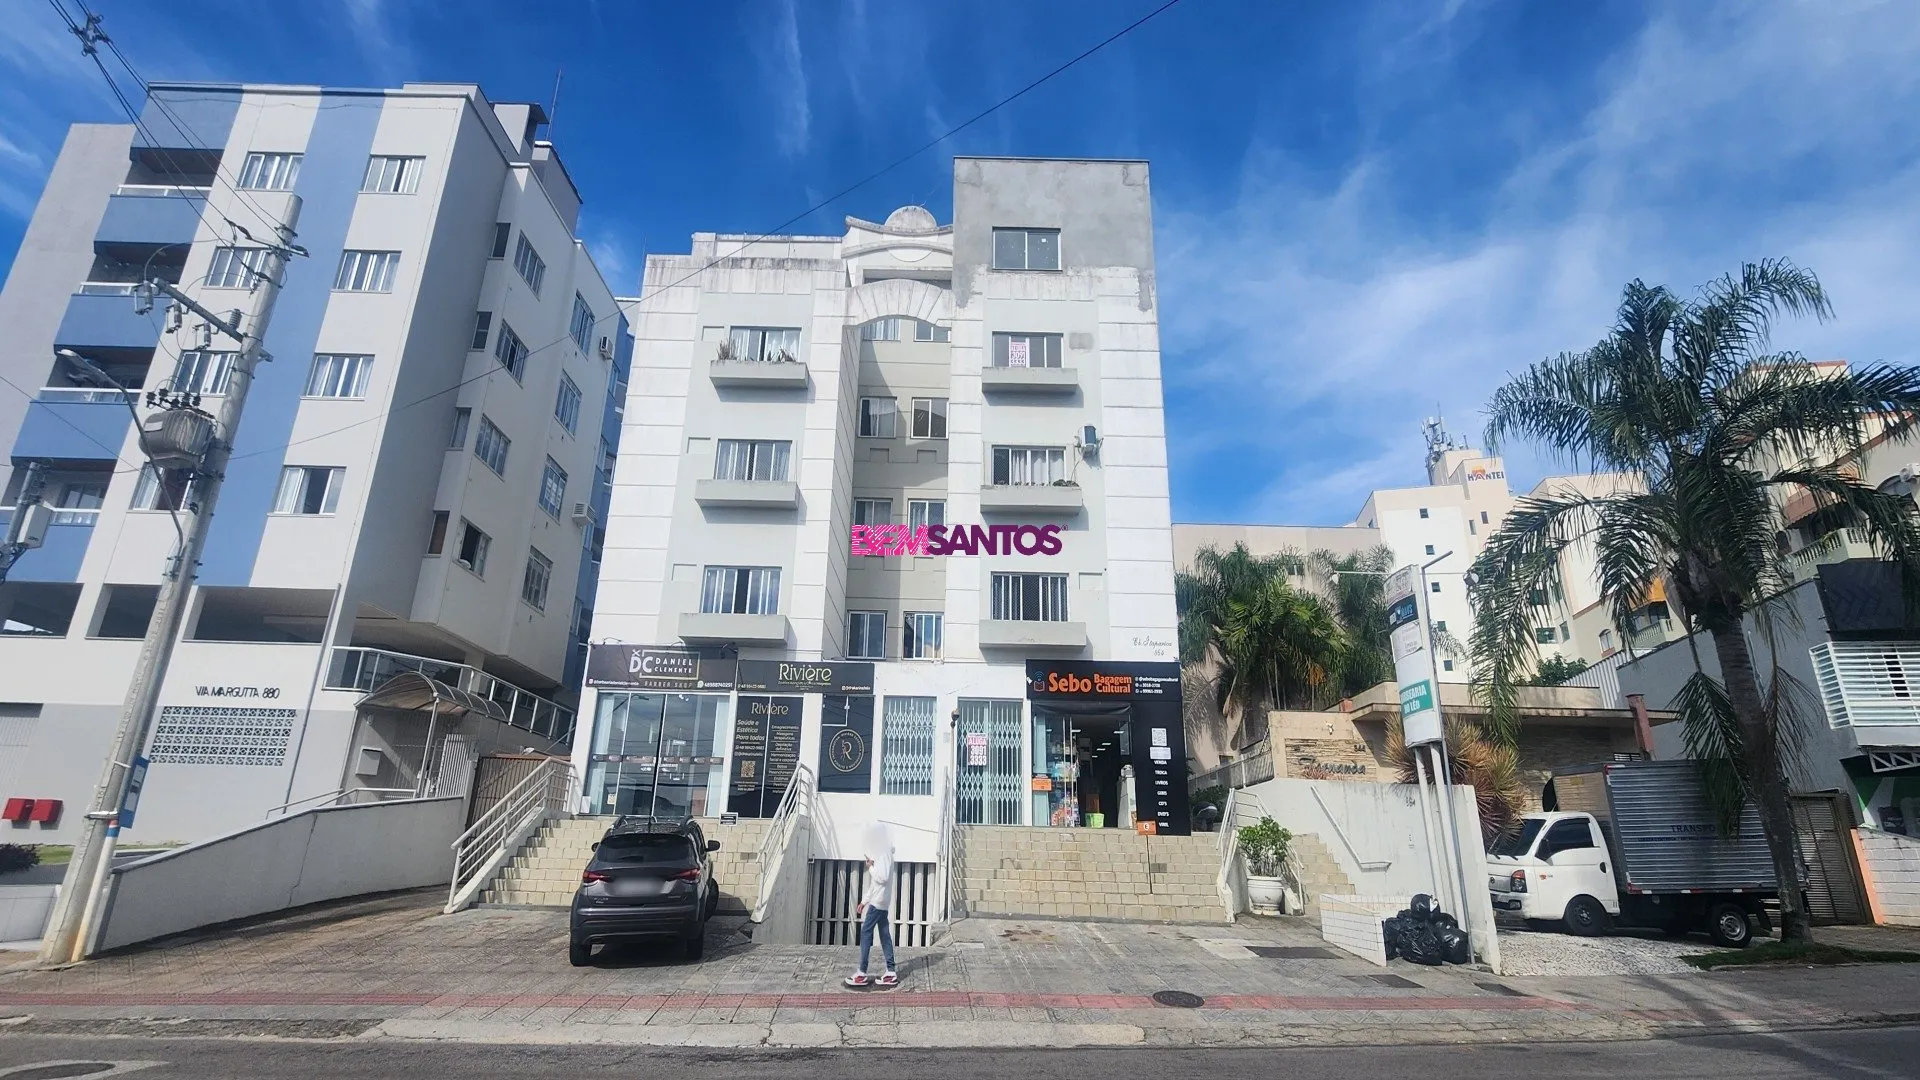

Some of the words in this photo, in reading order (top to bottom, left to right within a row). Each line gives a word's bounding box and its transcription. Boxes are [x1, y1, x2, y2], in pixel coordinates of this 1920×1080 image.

[629, 656, 653, 673] DC
[655, 657, 693, 667] DANIEL
[654, 665, 693, 674] CLEMENTE
[779, 663, 832, 681] Rivière
[644, 680, 671, 688] BARBER
[674, 681, 693, 689] SHOP
[1048, 672, 1091, 693] Sebo
[1093, 674, 1132, 684] Bagagem
[195, 685, 209, 697] VIA
[211, 686, 259, 698] MARGUTTA
[262, 687, 280, 699] 880
[1096, 683, 1131, 694] Cultural
[751, 702, 789, 715] Rivière
